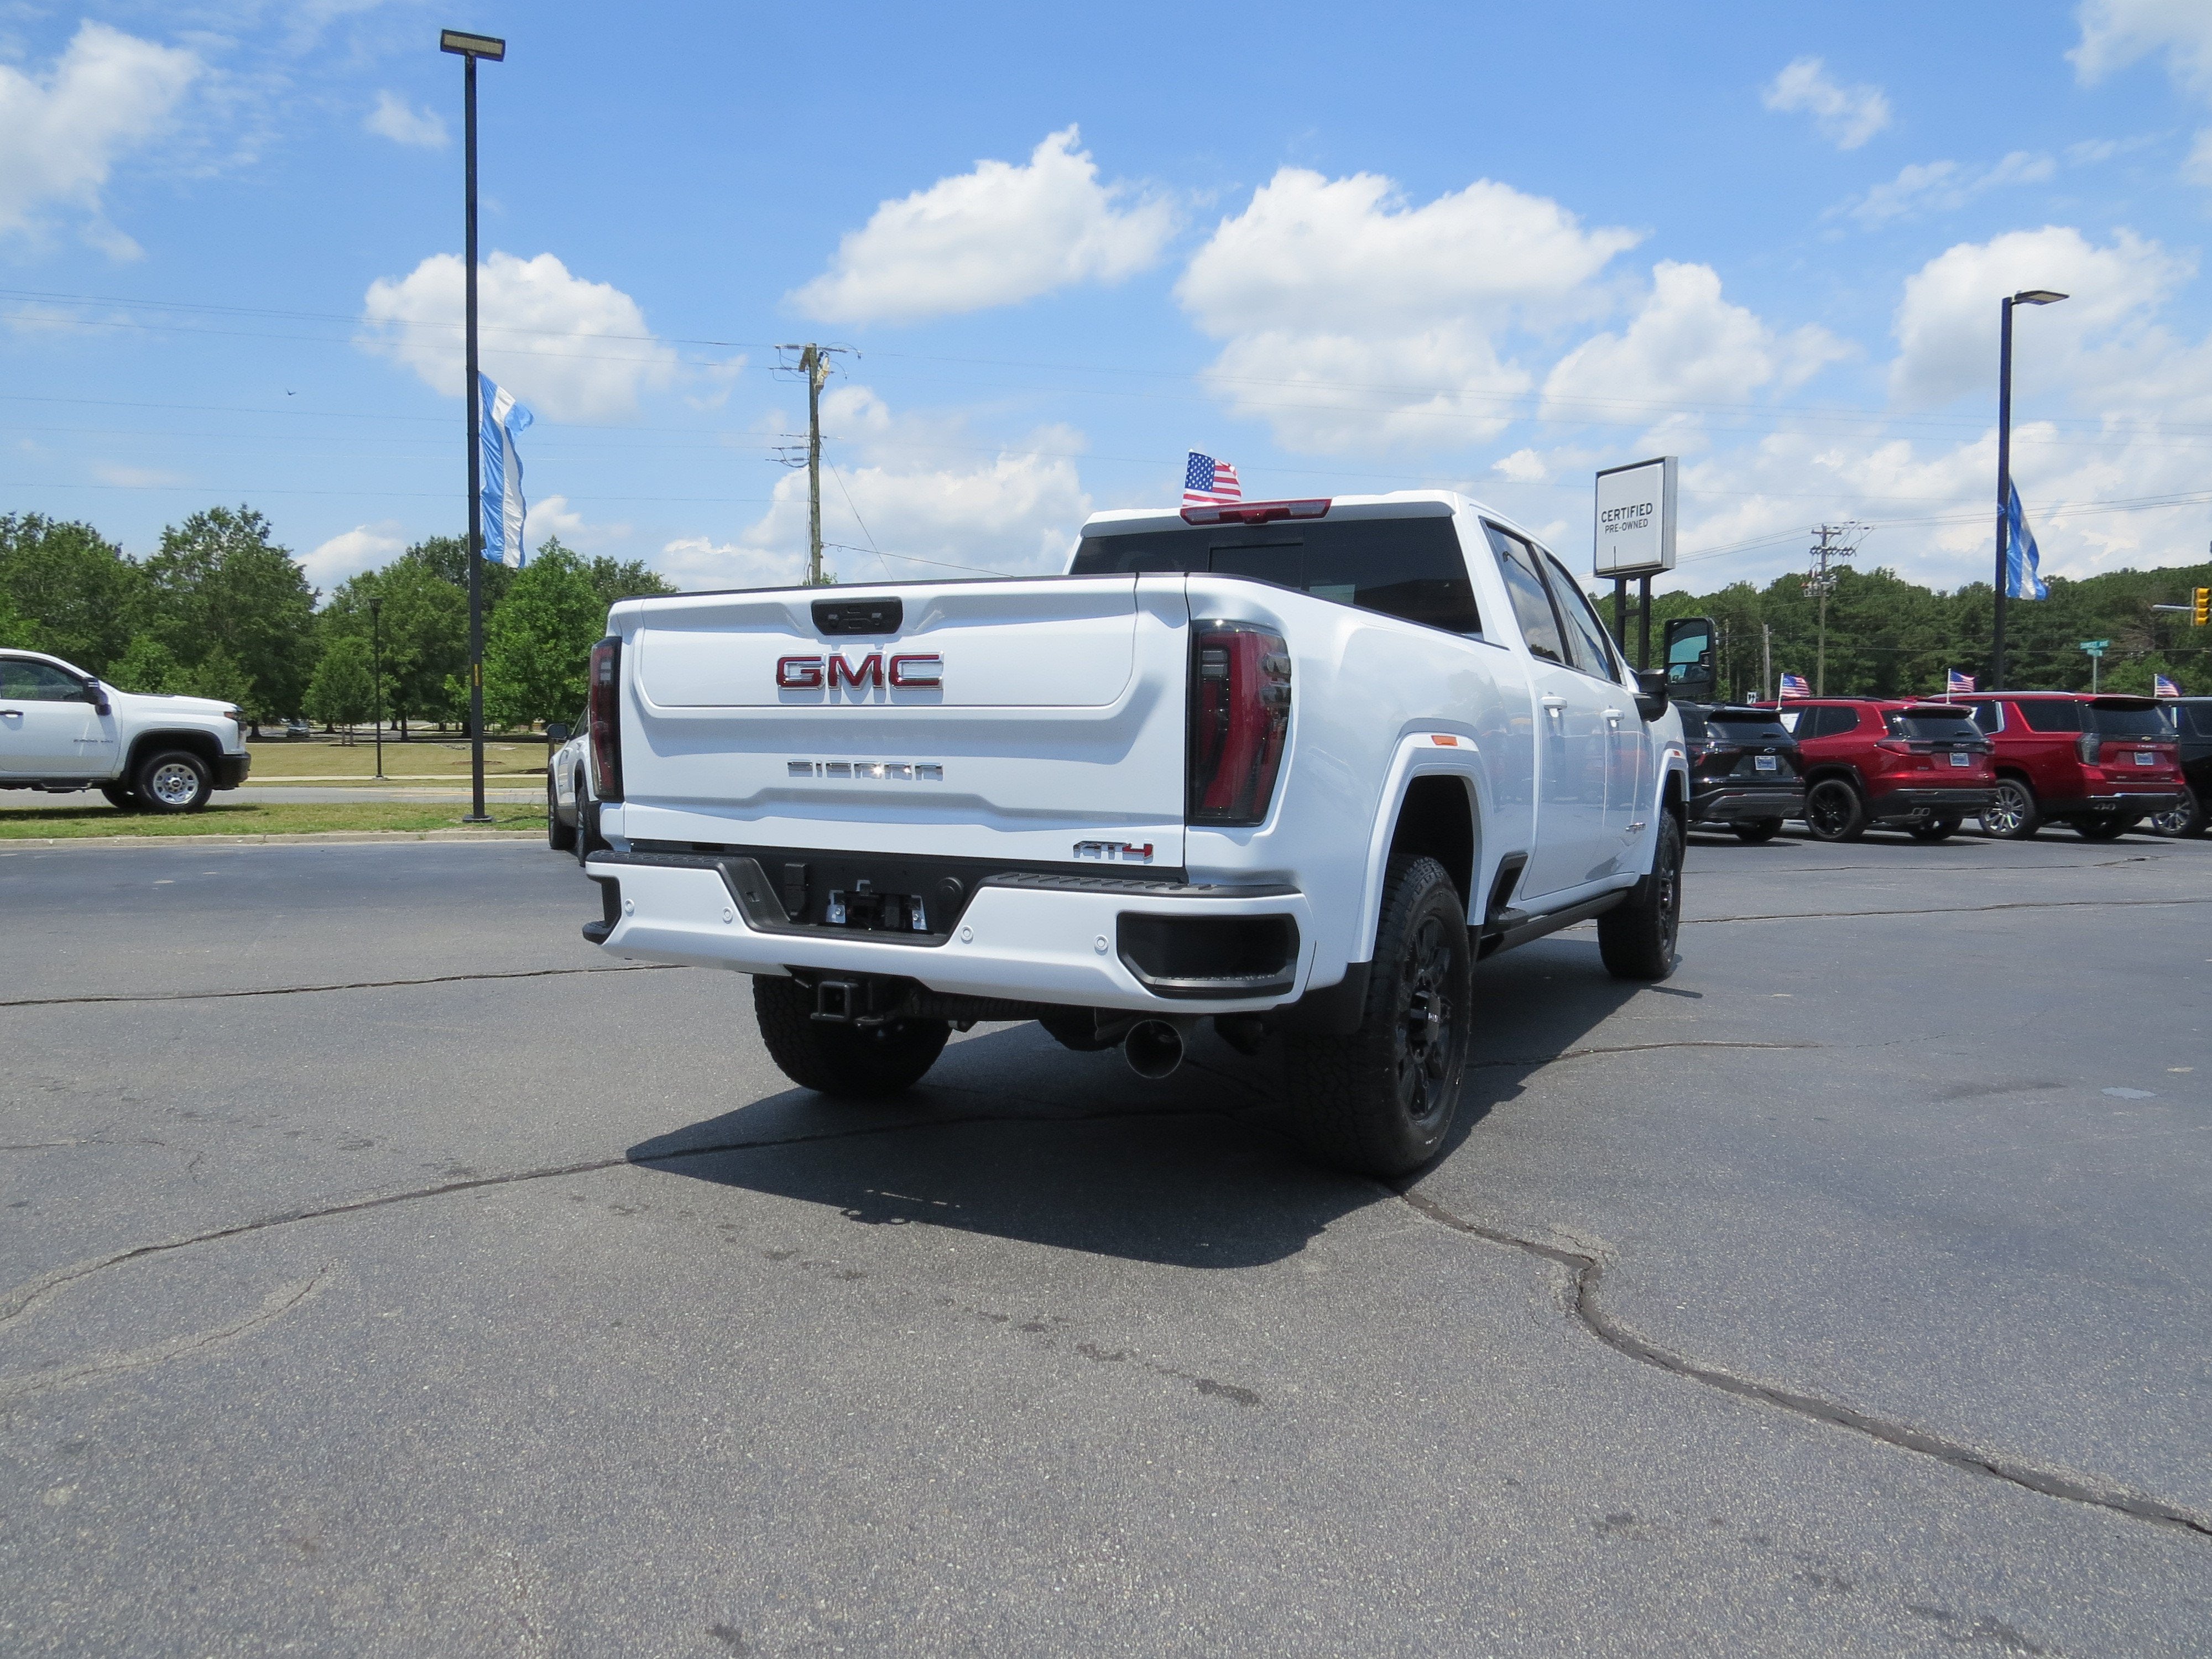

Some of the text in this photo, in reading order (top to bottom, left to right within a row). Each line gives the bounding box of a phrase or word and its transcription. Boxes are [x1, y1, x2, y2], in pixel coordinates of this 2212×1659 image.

[1601, 503, 1652, 523] CERTIFIED
[1605, 519, 1648, 534] PRE-OWNED
[776, 651, 943, 690] GMC
[787, 759, 943, 780] SIERRA
[1073, 840, 1154, 860] AT4
